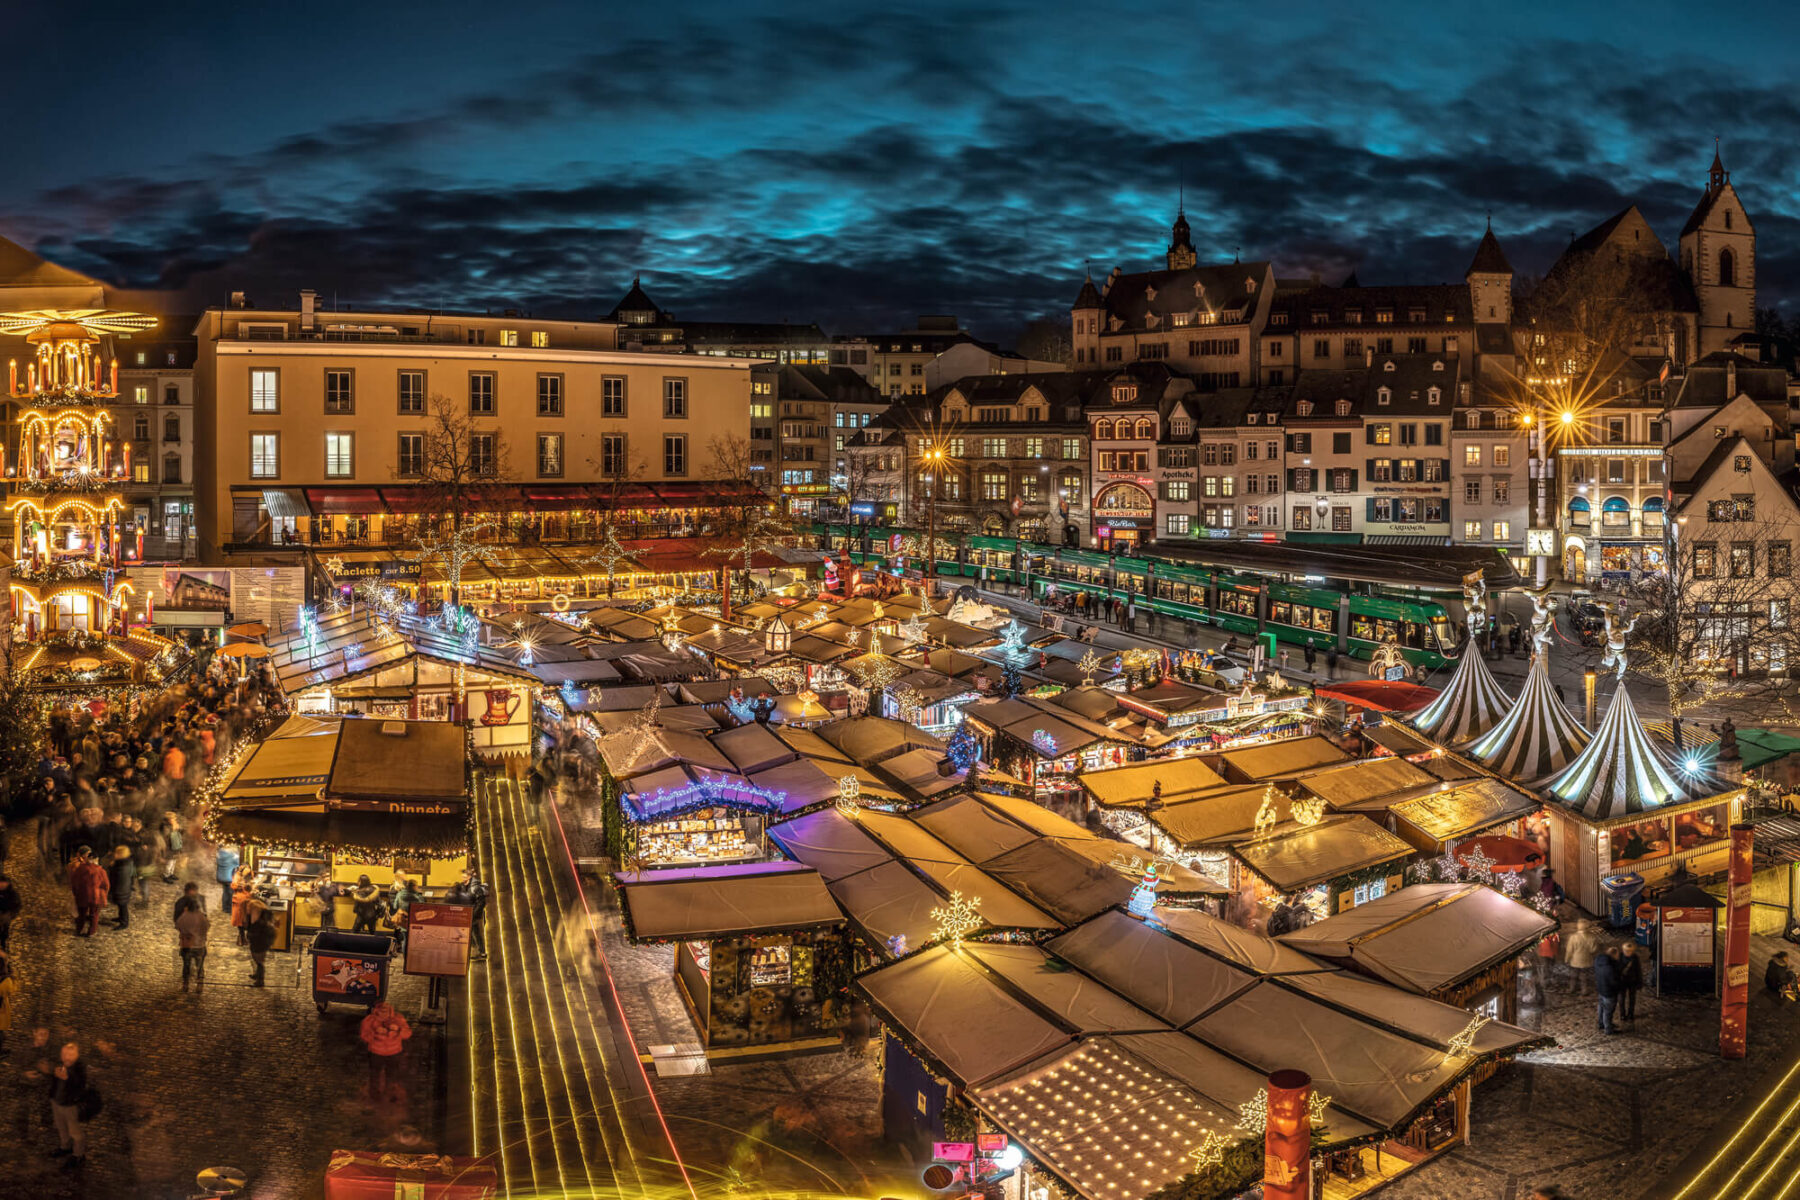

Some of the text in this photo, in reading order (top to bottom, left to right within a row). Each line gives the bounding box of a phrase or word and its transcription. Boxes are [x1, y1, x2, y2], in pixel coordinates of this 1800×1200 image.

[1162, 471, 1194, 479] Apotheke
[399, 565, 420, 574] 8.50
[256, 776, 324, 786] Dinnete
[389, 802, 450, 814] Dinnete
